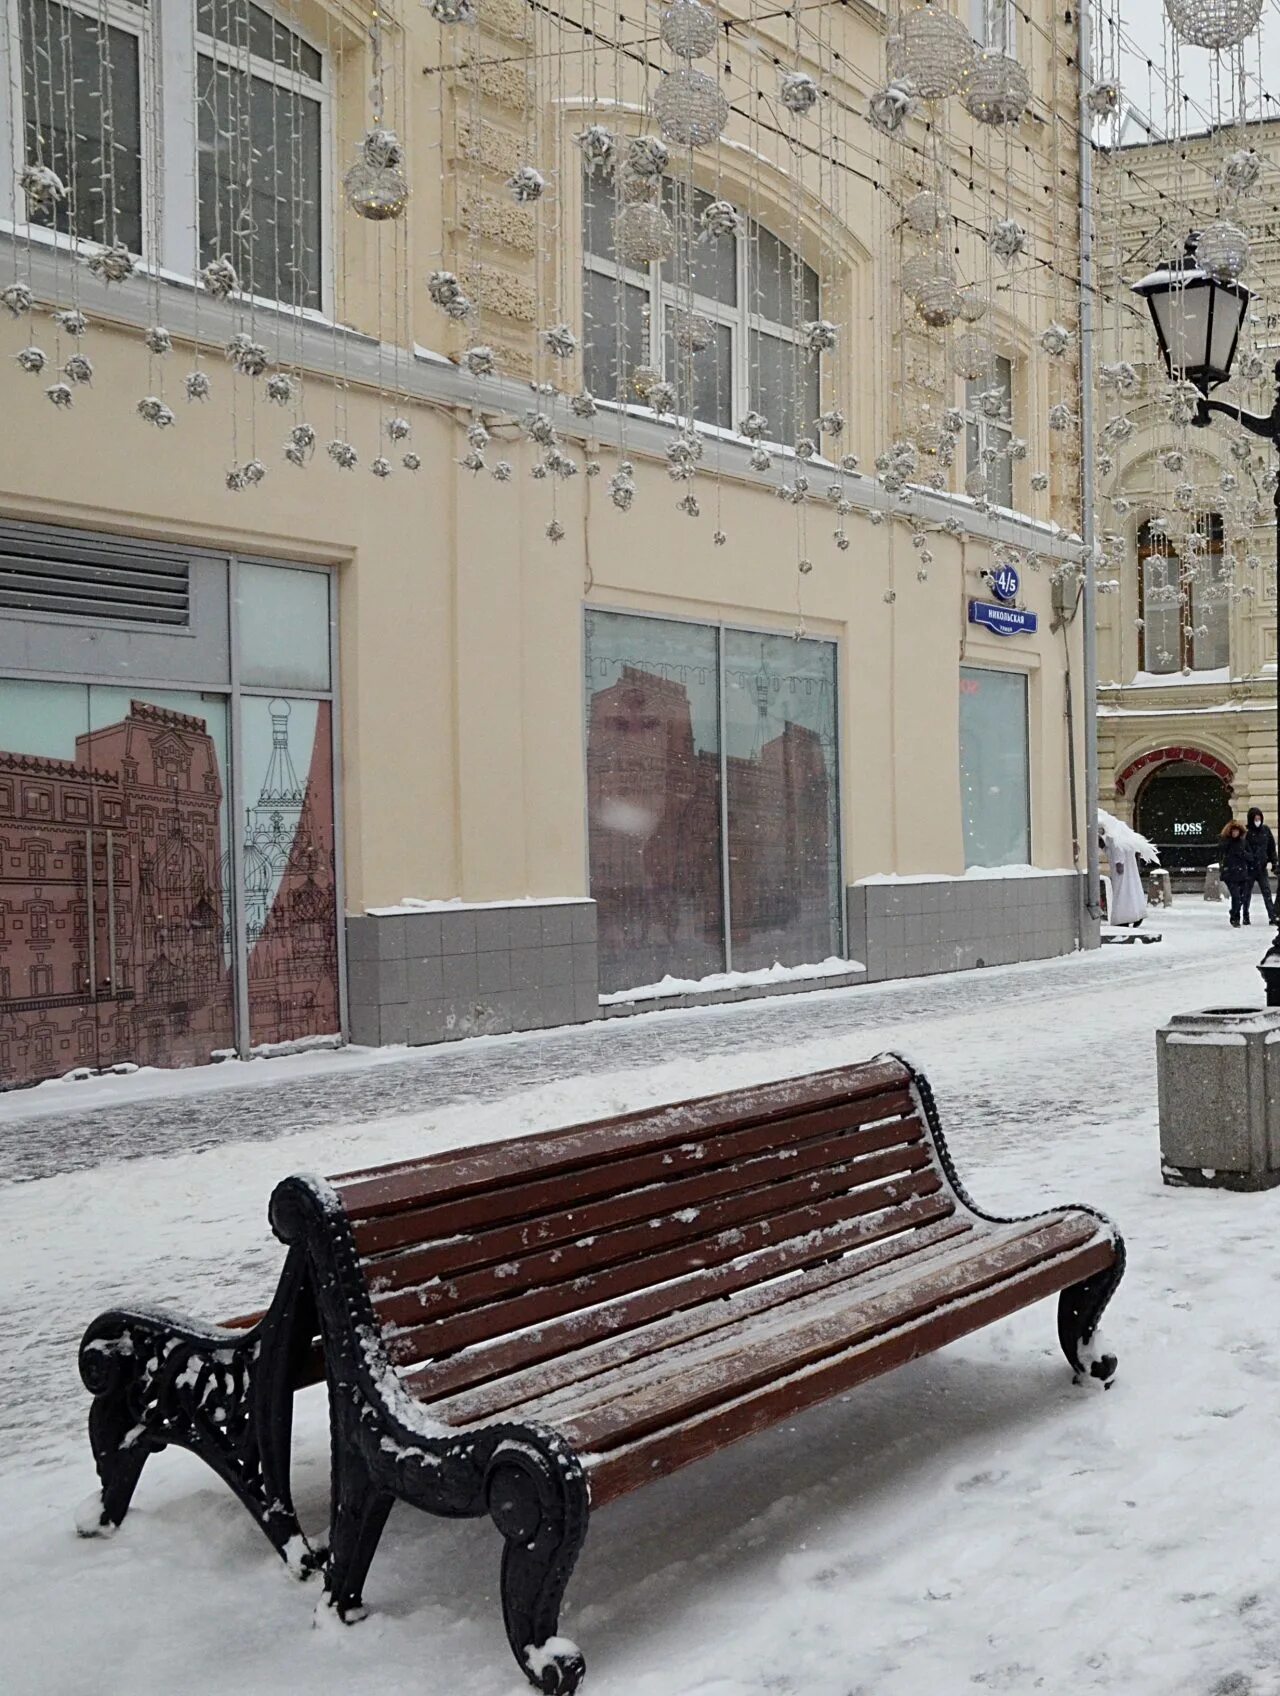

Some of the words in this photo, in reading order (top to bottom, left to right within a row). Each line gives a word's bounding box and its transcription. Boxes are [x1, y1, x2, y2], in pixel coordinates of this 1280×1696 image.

[998, 572, 1016, 592] 4/5
[988, 609, 1024, 624] НИКОЛЬСКАЯ
[1174, 823, 1202, 832] BOSS
